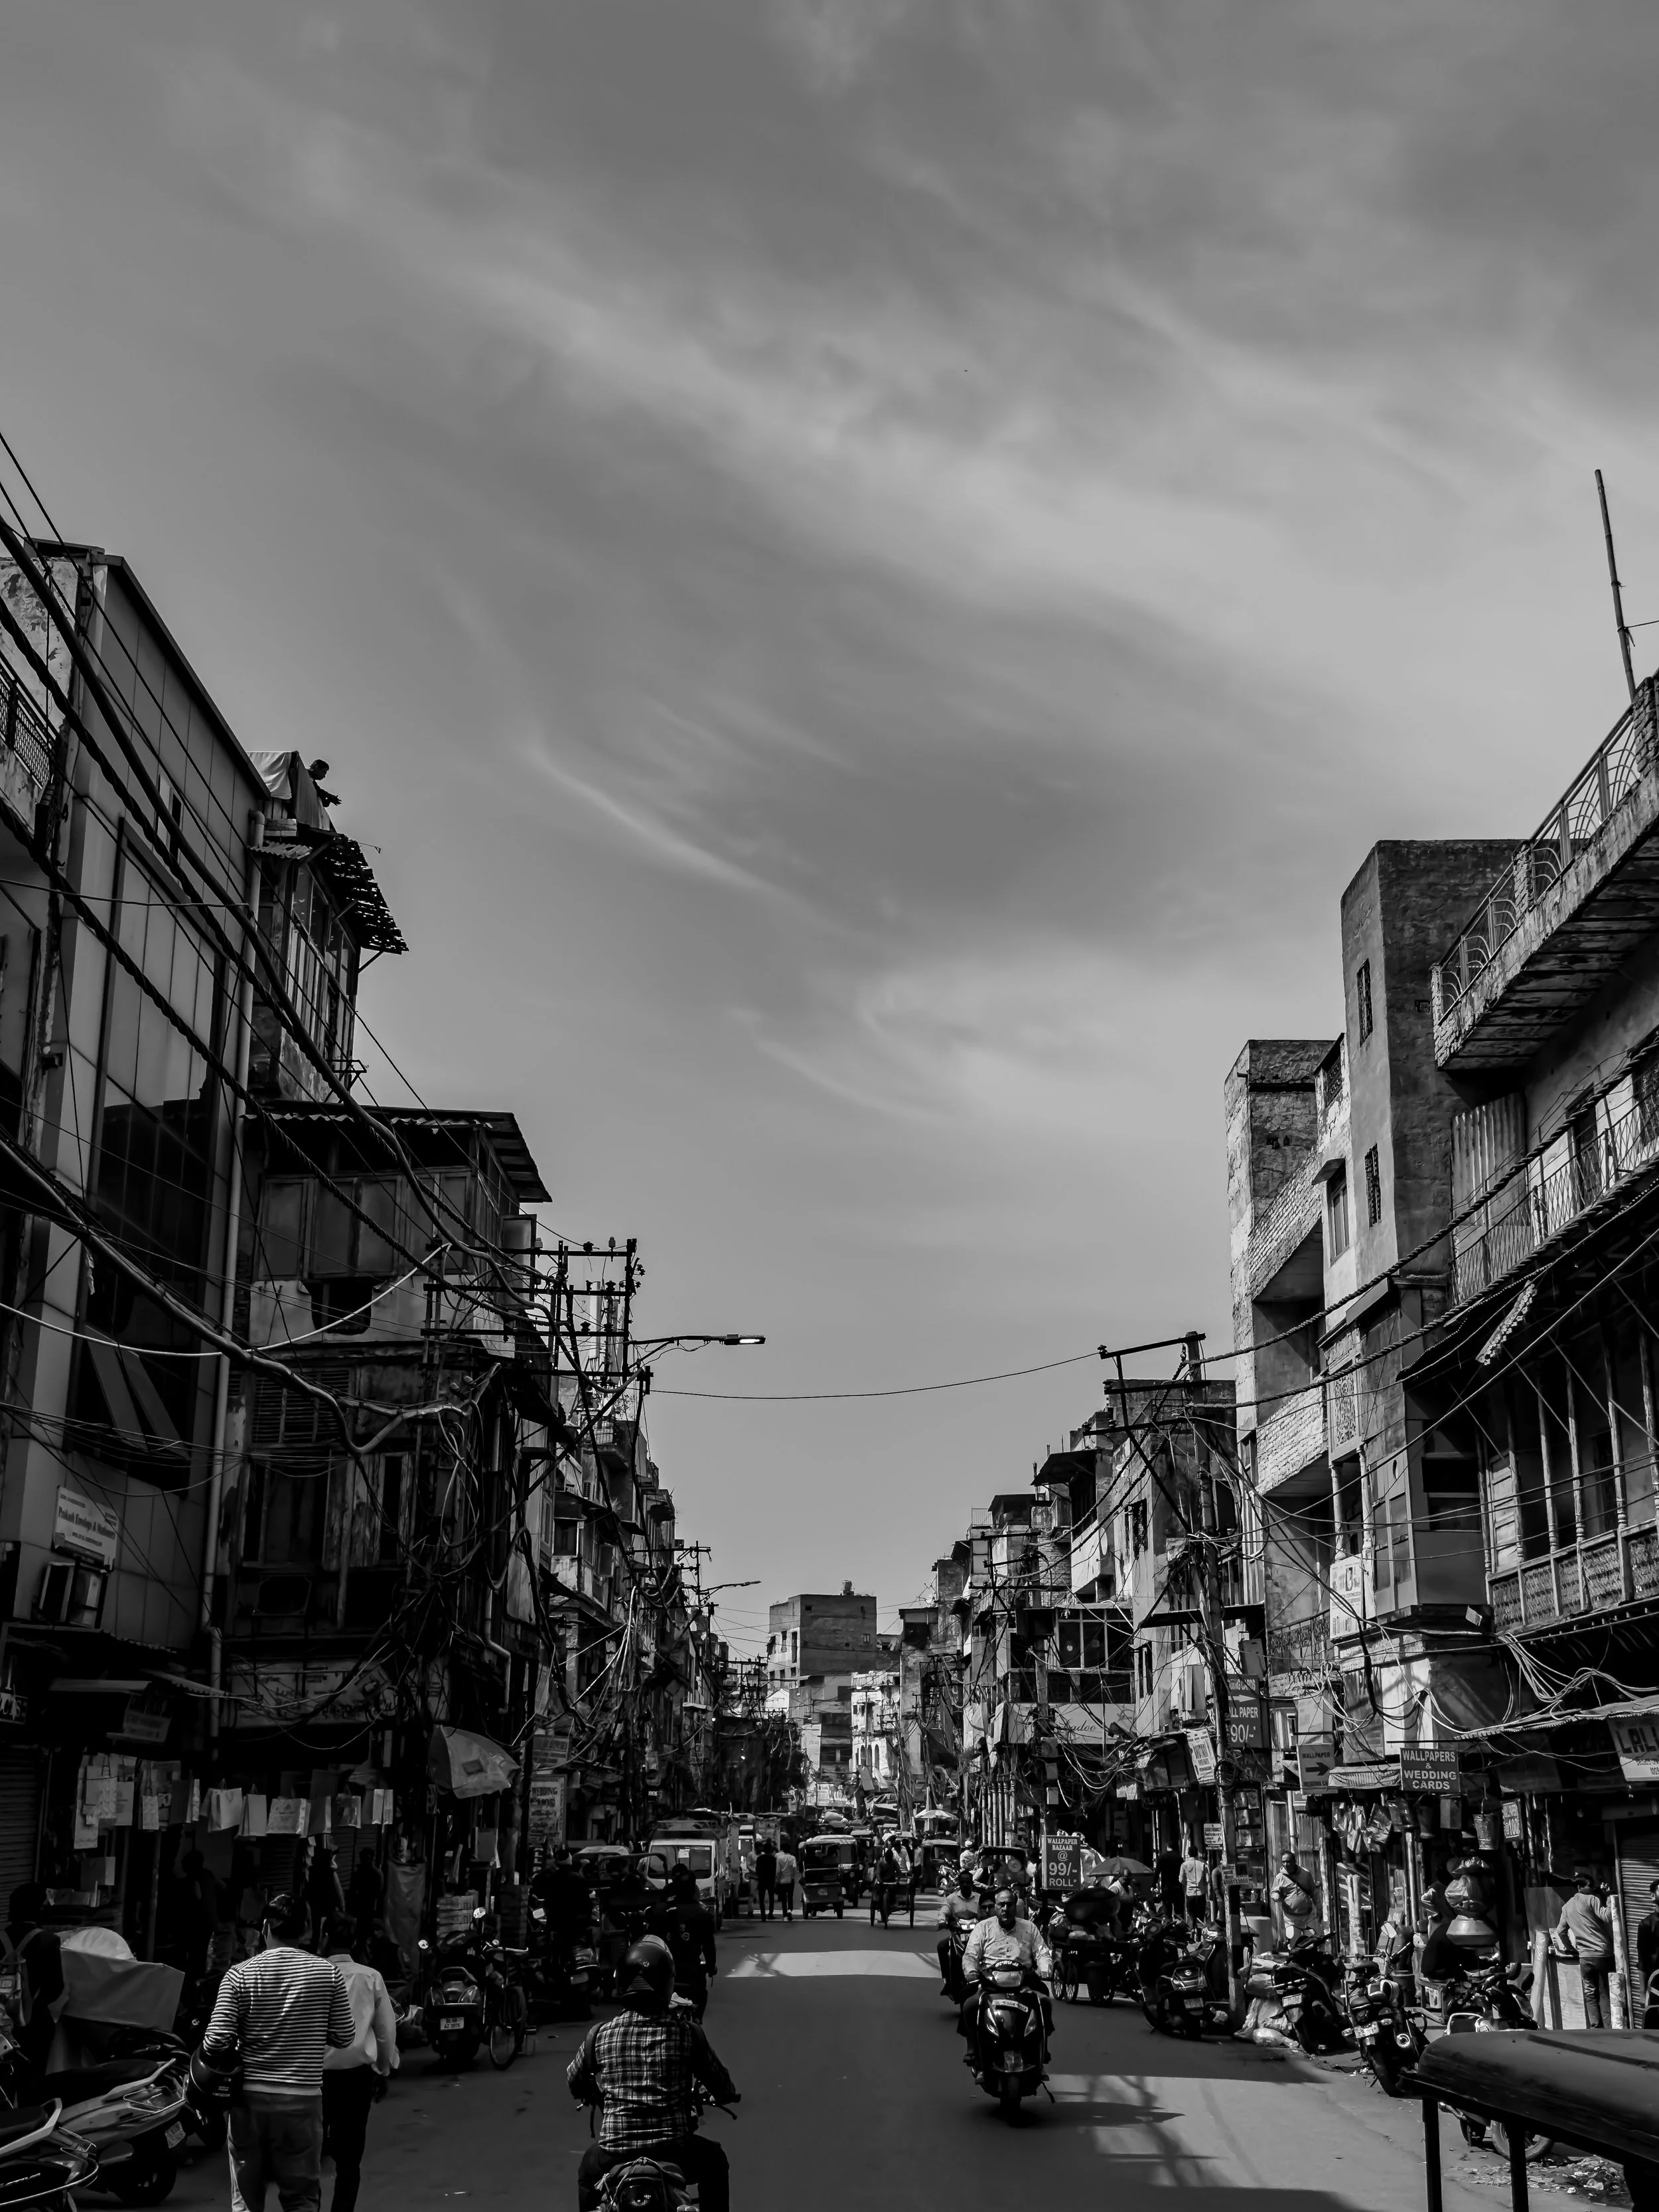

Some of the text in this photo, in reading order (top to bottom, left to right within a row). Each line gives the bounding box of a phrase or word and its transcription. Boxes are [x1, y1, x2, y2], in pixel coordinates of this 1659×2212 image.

[1239, 1706, 1259, 1718] PAPER
[1402, 1749, 1456, 1762] WALLPAPERS
[1404, 1769, 1457, 1780] WEDDING
[1412, 1780, 1451, 1790] CARDS
[1057, 1850, 1068, 1862] @
[1048, 1862, 1078, 1876] 99/-
